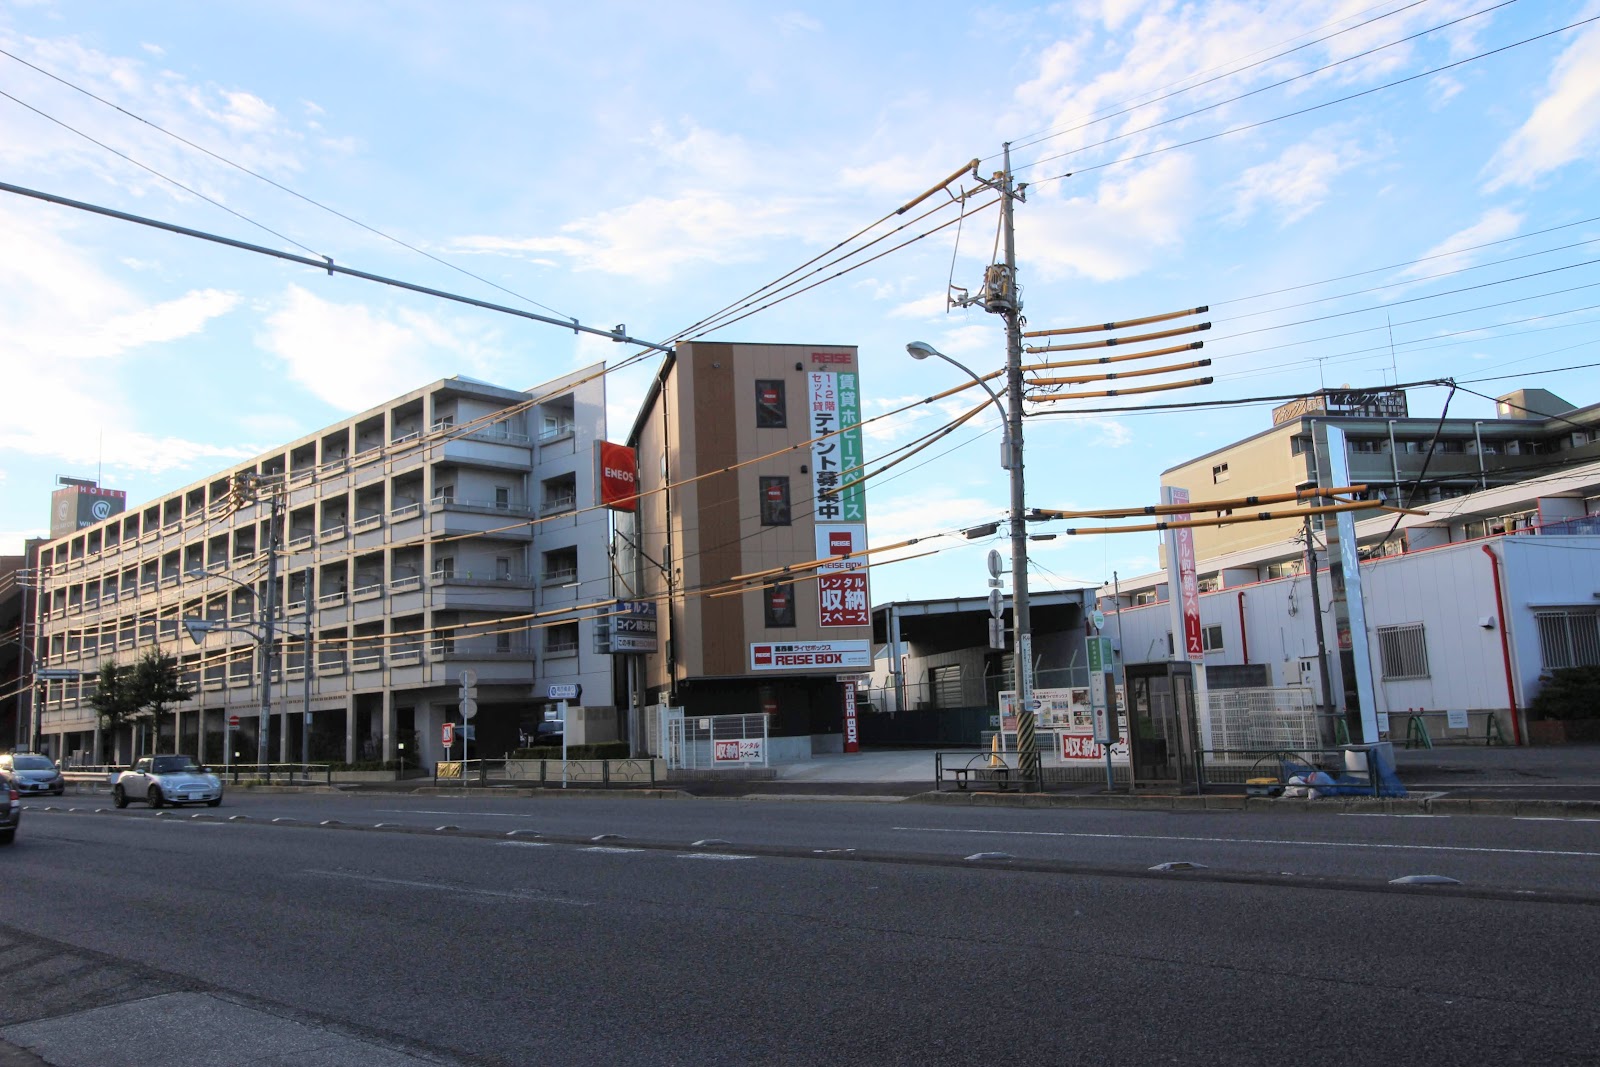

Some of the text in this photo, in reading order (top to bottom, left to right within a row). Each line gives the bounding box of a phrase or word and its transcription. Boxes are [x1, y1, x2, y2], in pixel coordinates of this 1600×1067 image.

[812, 353, 851, 364] REISE
[815, 413, 840, 519] テナント募集中
[604, 467, 634, 483] ENEOS
[80, 486, 124, 498] HOTEL
[820, 578, 865, 589] レンタル
[821, 589, 866, 611] 収納
[822, 612, 867, 623] スペース
[775, 654, 813, 666] REISE
[815, 653, 843, 665] BOX
[845, 683, 856, 717] REISE
[847, 718, 857, 743] BOX
[716, 743, 739, 759] 収納
[1065, 737, 1100, 757] 収納
